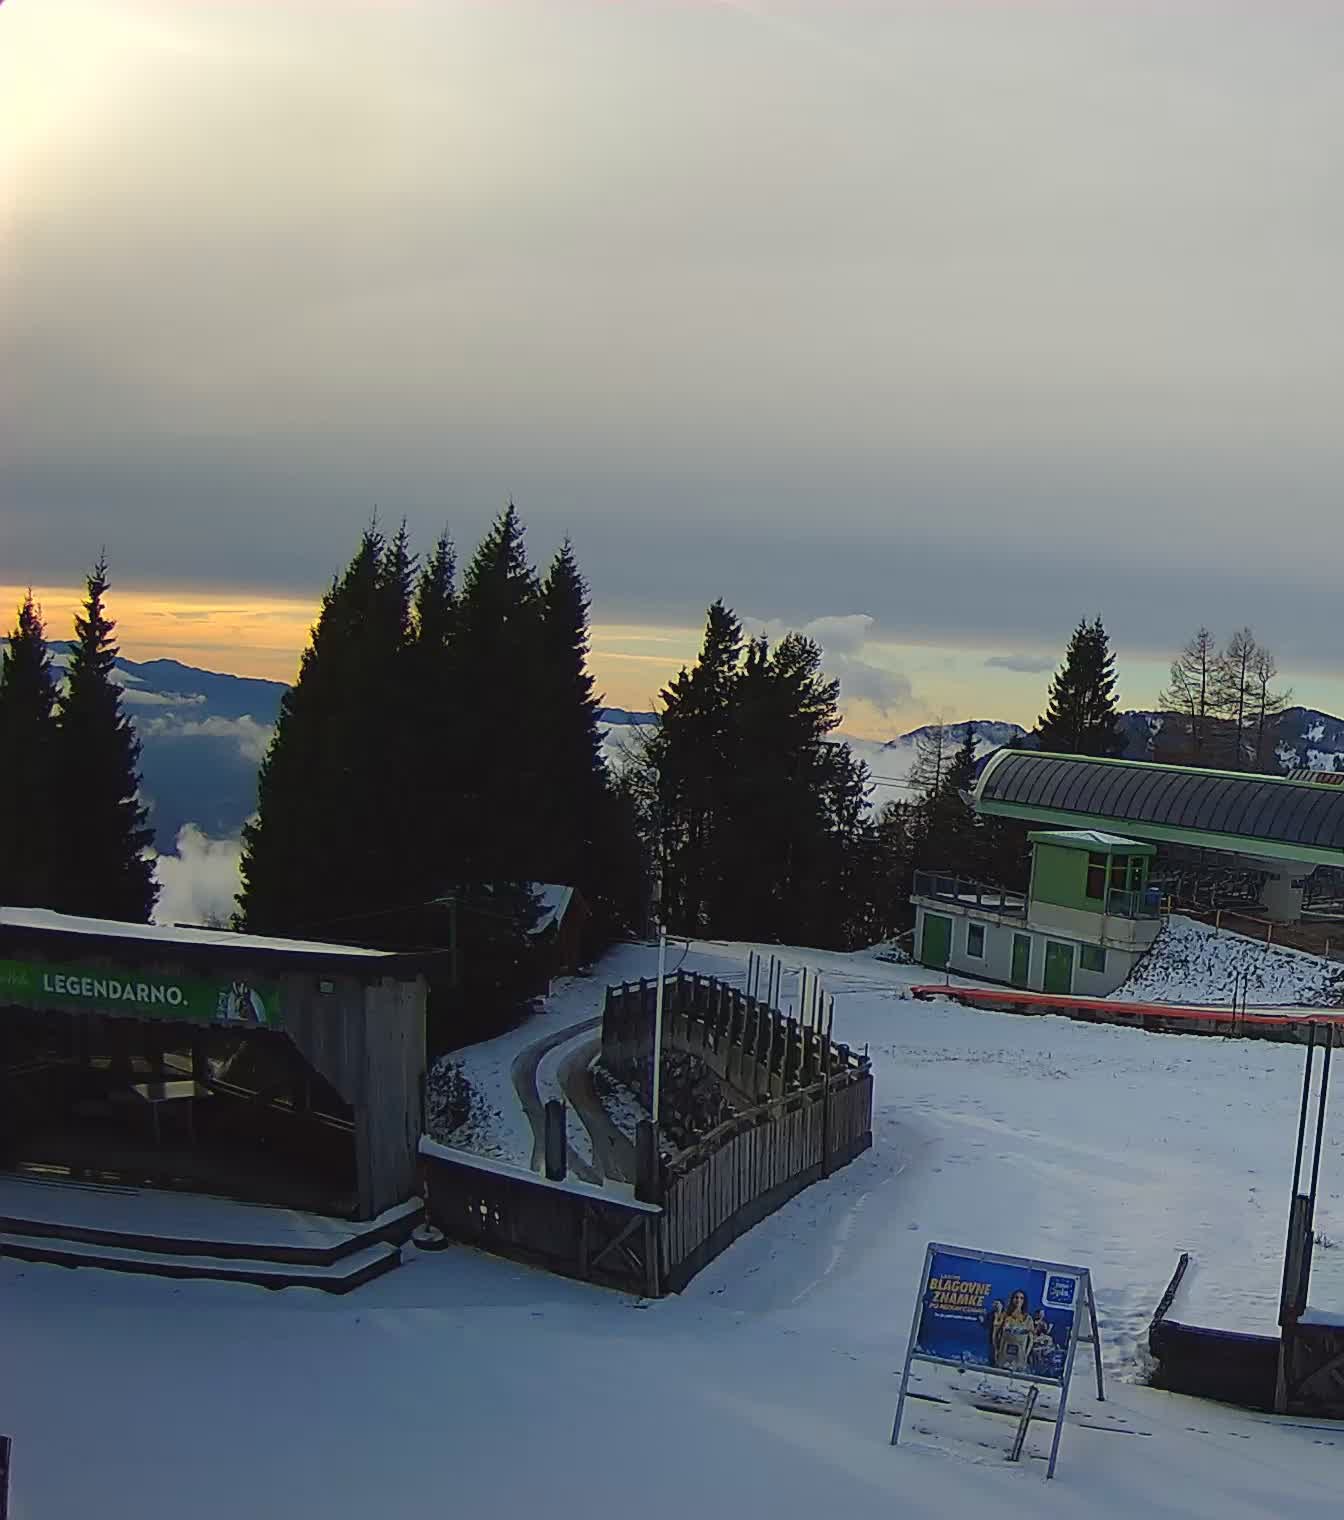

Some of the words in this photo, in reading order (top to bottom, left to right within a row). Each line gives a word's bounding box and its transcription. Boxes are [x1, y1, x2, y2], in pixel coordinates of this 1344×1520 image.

[43, 973, 189, 1006] LEGENDARNO.
[929, 1278, 993, 1296] BLAGOVNE
[932, 1291, 985, 1307] ZNAMKE
